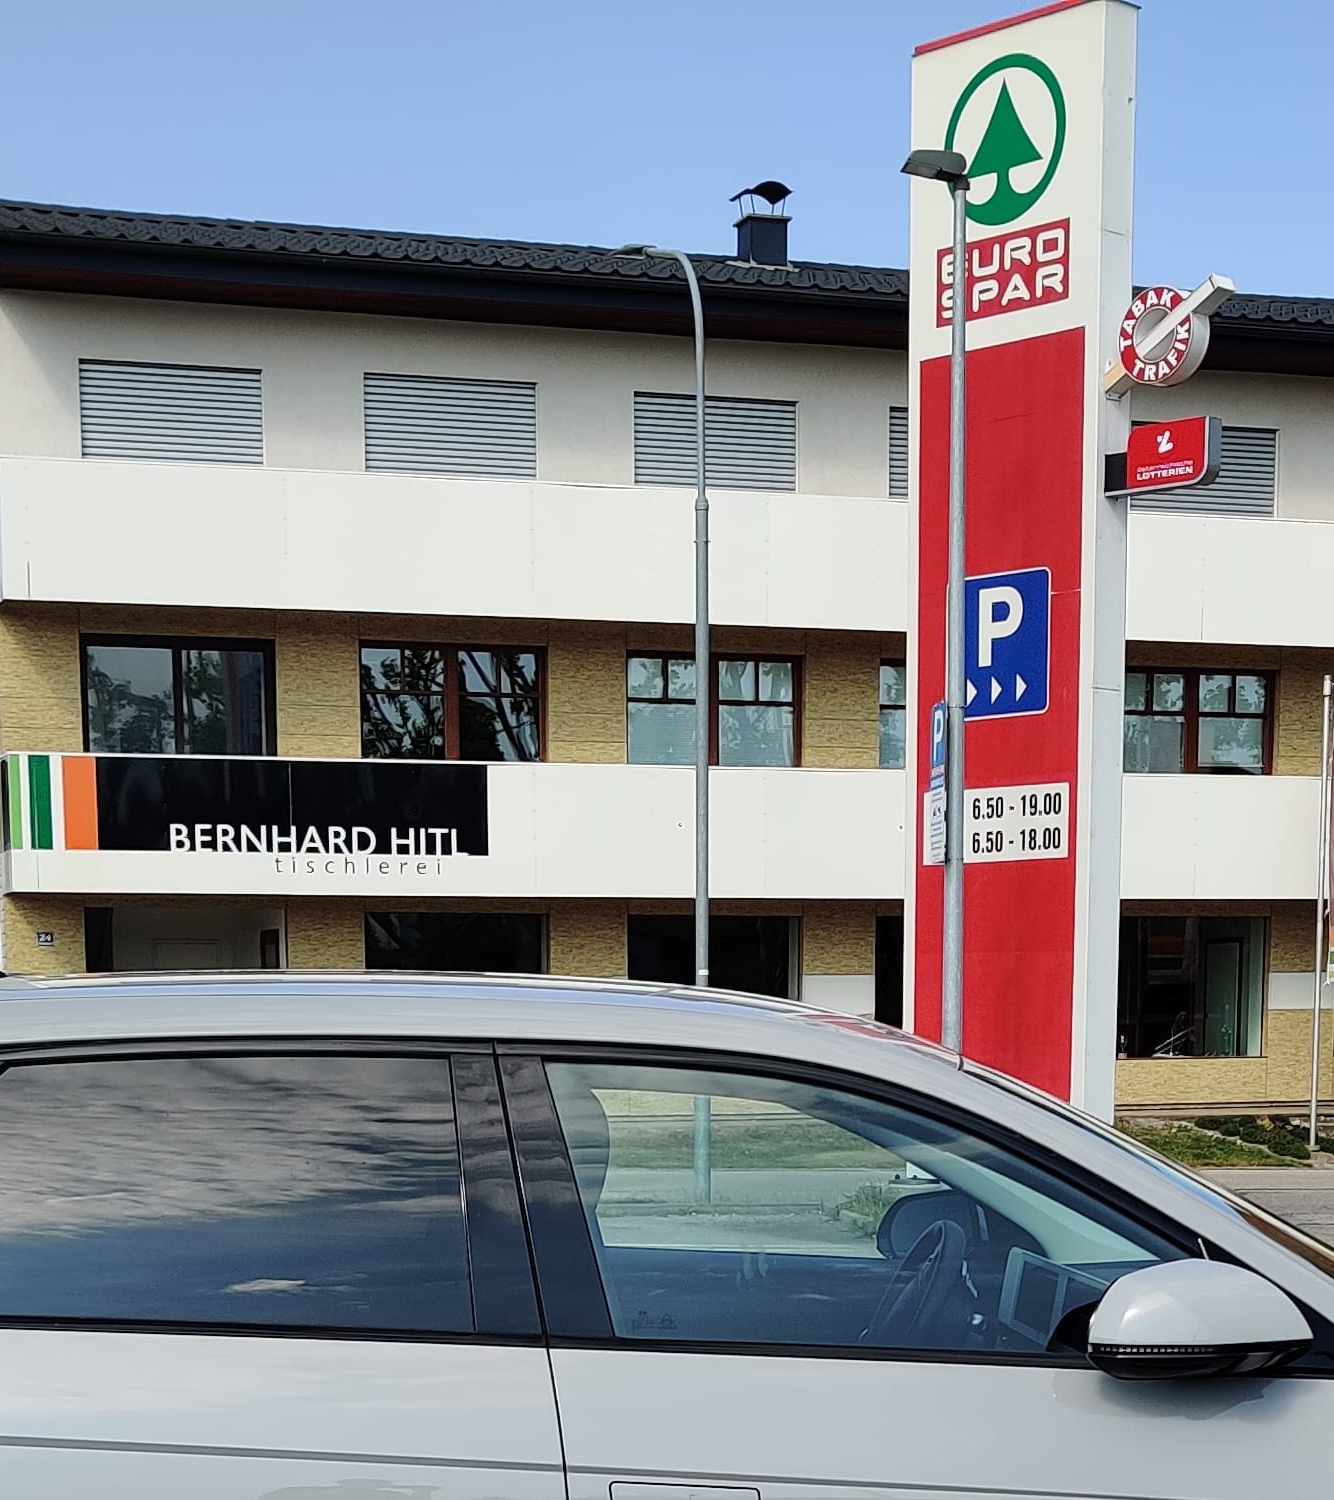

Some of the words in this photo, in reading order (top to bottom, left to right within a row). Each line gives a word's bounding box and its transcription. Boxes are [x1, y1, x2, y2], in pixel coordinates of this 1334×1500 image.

[941, 228, 1065, 285] EURO
[1120, 288, 1175, 351] TABAK
[1132, 321, 1190, 380] TRAFIK
[1136, 466, 1194, 480] LOTTERIEN
[979, 586, 1023, 668] P
[933, 709, 944, 762] P
[972, 796, 1004, 820] 6.50
[1020, 792, 1062, 816] 19.00
[169, 823, 377, 855] BERNHARD
[390, 826, 470, 856] HITL
[972, 830, 1003, 853] 6.50
[1019, 827, 1061, 851] 18.00
[274, 857, 441, 875] tischlerei
